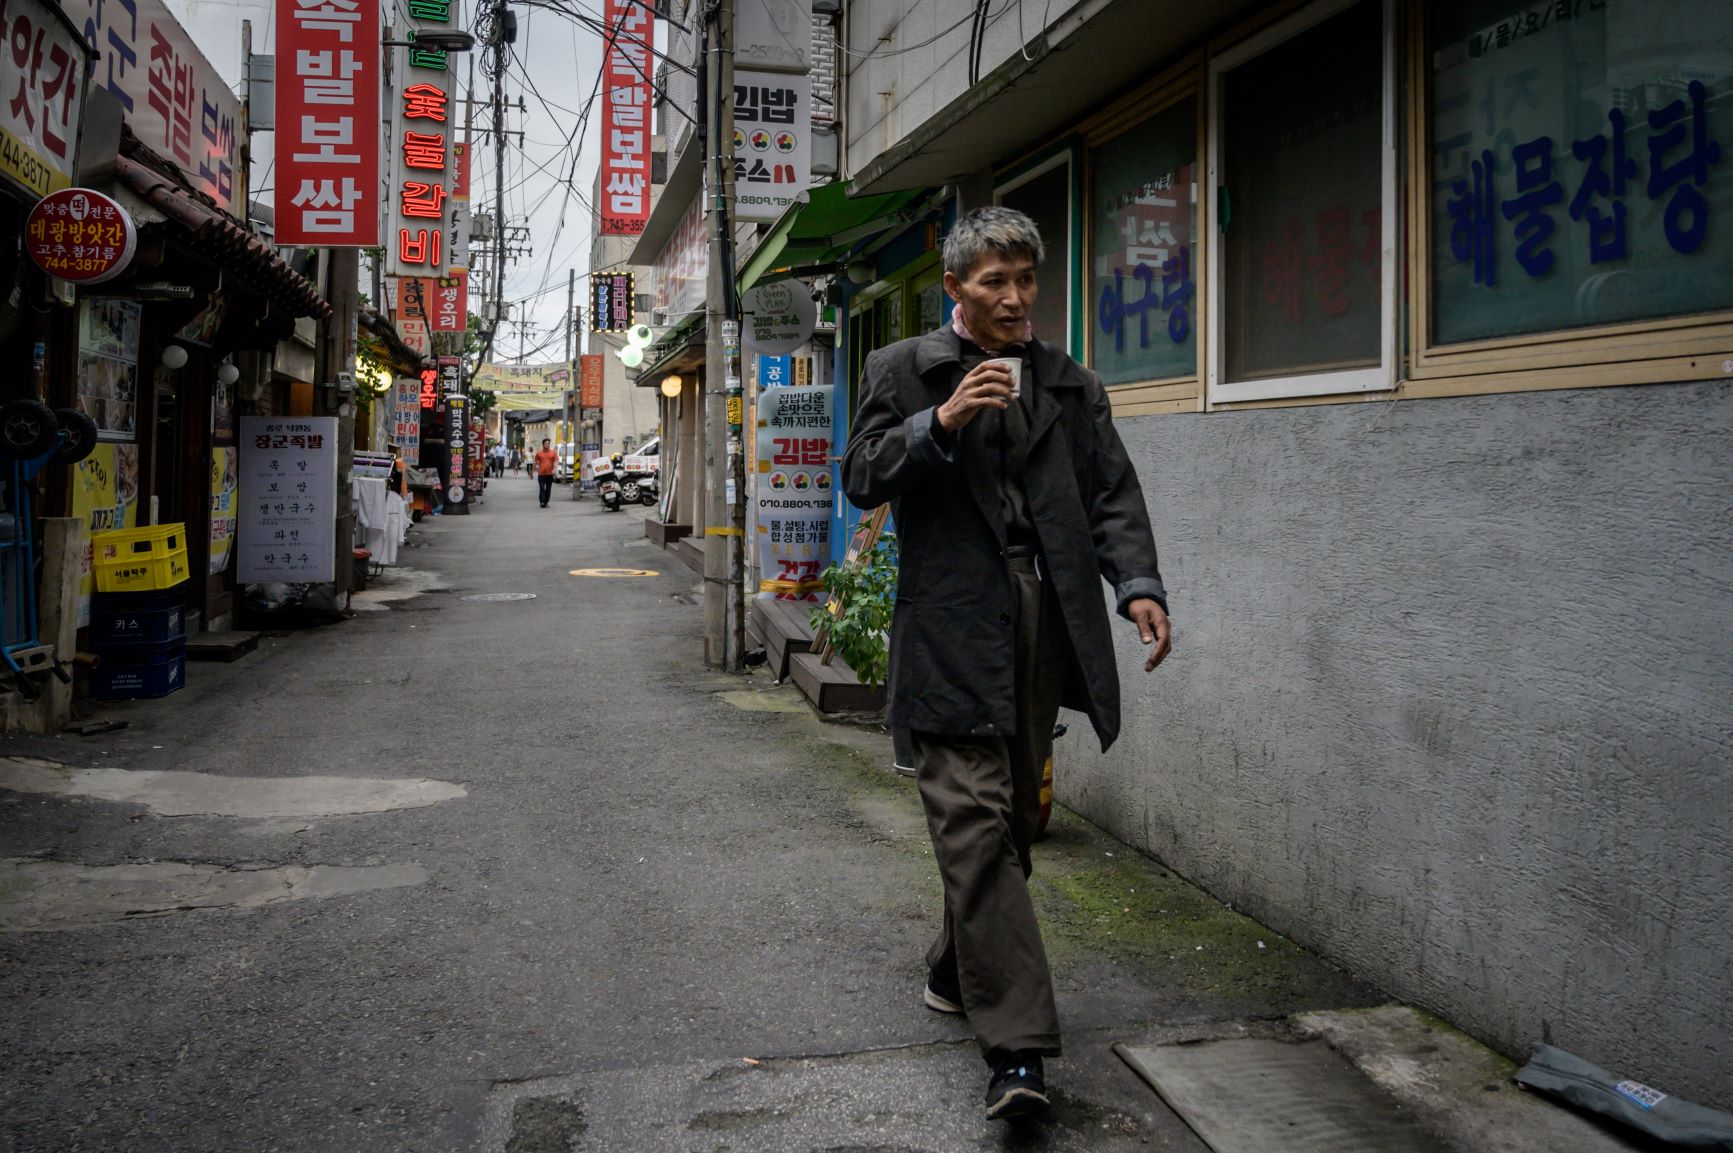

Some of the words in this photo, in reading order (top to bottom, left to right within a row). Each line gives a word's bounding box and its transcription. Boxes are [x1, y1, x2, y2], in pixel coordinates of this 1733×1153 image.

[0, 0, 77, 160] 앗간
[733, 85, 797, 124] 김밥
[400, 83, 448, 268] 숯불갈비
[1446, 80, 1720, 288] 해물잡탕
[43, 202, 70, 216] 맞춤
[72, 196, 86, 219] 떡
[90, 206, 116, 220] 전문
[30, 218, 124, 246] 대광방앗간
[44, 257, 108, 271] 744-3877
[440, 288, 457, 329] 생오리
[1099, 245, 1194, 353] 아구탕
[510, 367, 543, 378] 흑돼지
[776, 404, 825, 416] 손맛으로
[778, 392, 825, 405] 집밥다운
[451, 409, 464, 440] 막국수
[255, 434, 324, 450] 장군족발
[772, 438, 829, 465] 김밥
[770, 532, 829, 544] 합성첨가물
[777, 560, 820, 583] 건강
[114, 619, 140, 630] 카스
